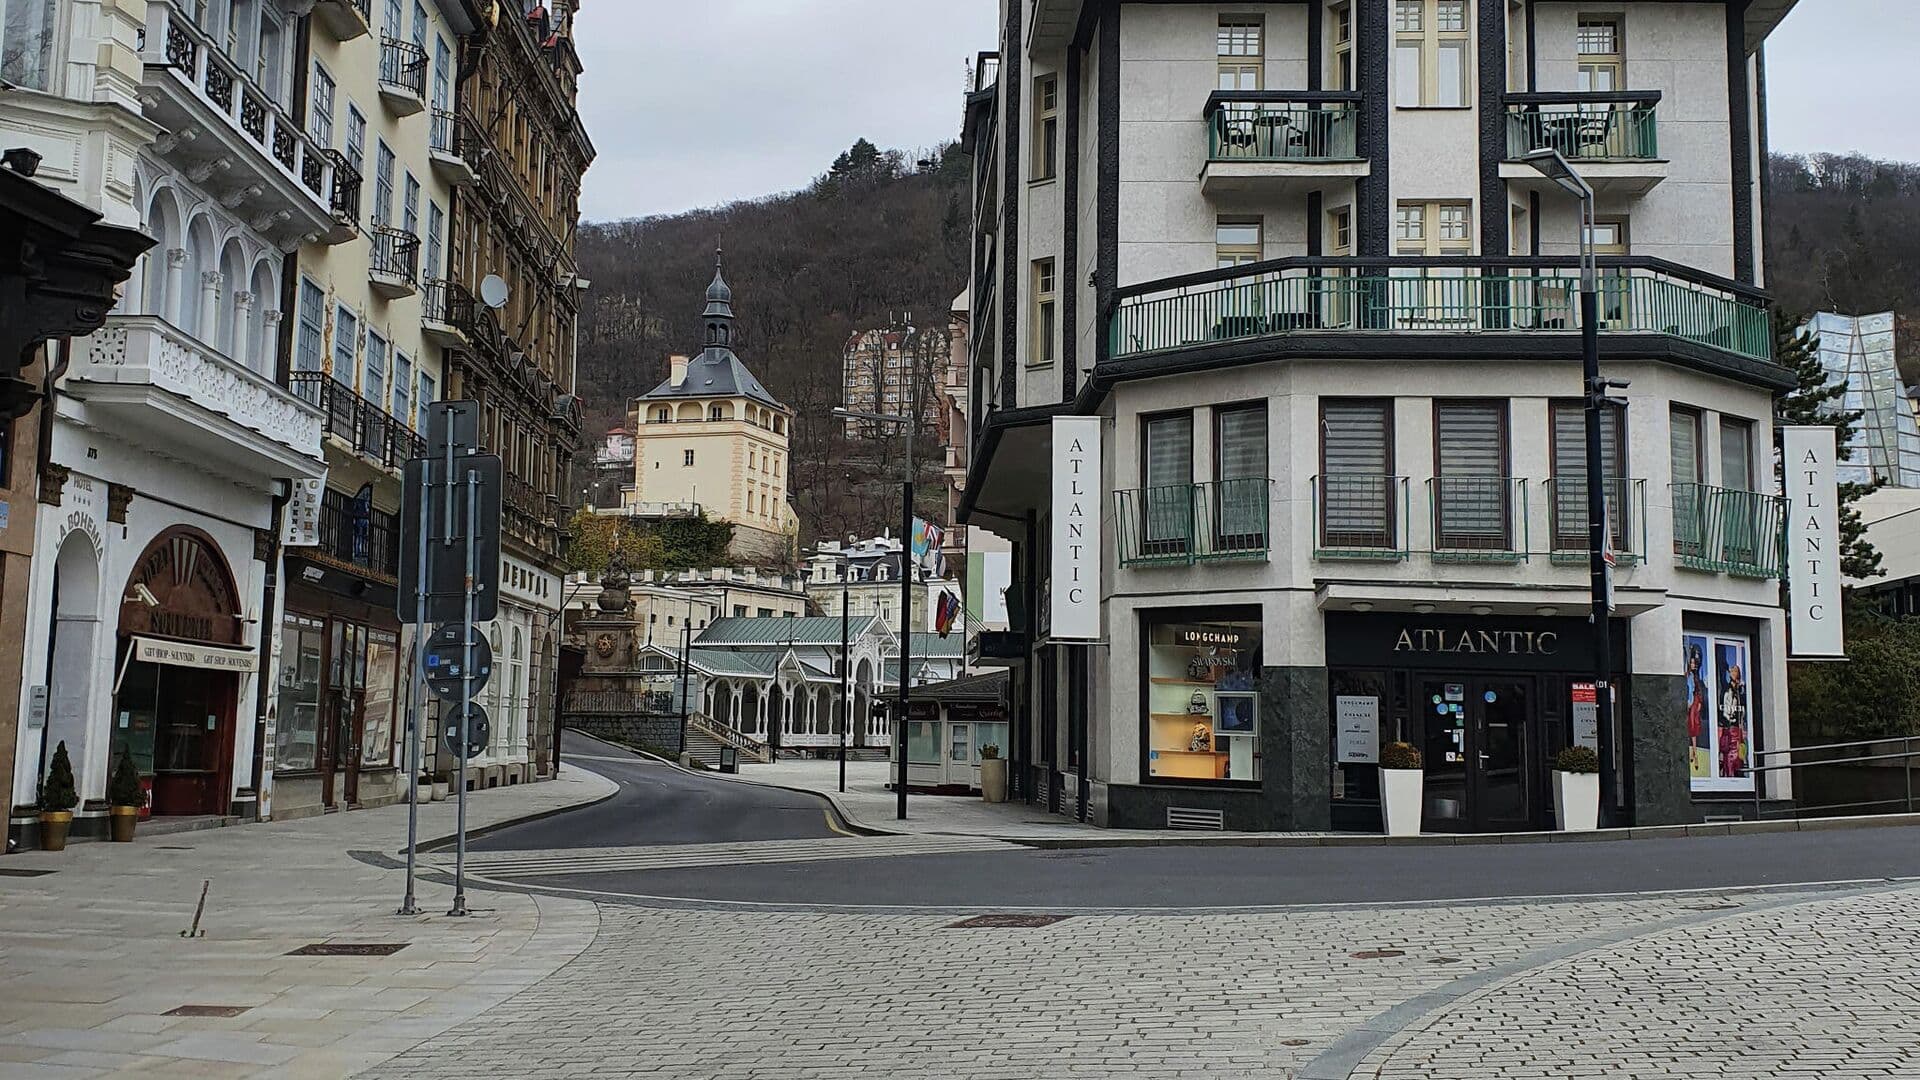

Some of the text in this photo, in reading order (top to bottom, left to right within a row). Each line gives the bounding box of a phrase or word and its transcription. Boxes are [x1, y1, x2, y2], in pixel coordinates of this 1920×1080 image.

[73, 476, 93, 492] HOTEL
[67, 511, 104, 562] BOHEMIA
[1069, 438, 1083, 604] ATLANTIC
[1803, 449, 1824, 620] ATLANTIC
[1185, 631, 1239, 643] LONGCHAMP
[1394, 628, 1558, 655] ATLANTIC
